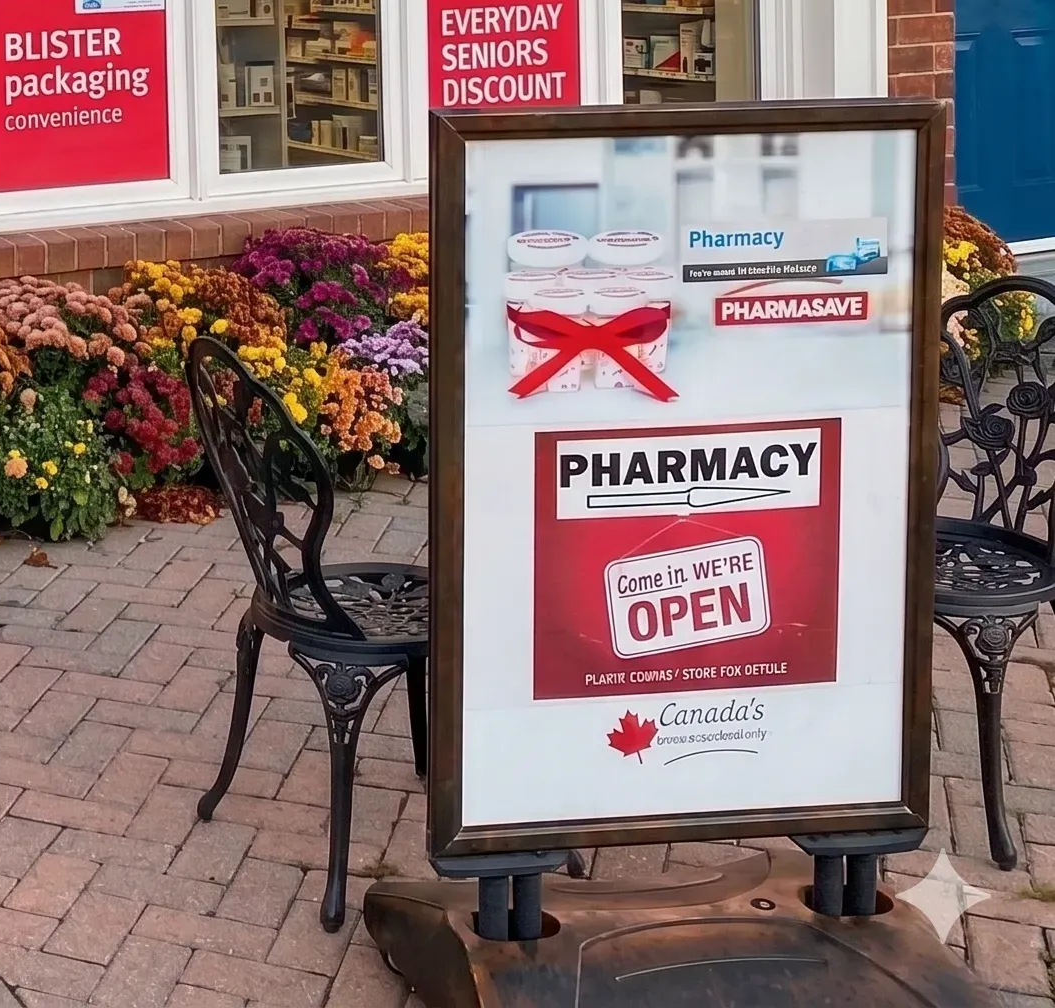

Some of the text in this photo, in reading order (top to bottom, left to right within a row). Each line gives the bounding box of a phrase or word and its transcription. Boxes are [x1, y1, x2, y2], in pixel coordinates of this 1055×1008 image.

[441, 3, 563, 37] EVERYDAY
[5, 27, 122, 62] BLISTER
[441, 38, 549, 71] SENIORS
[5, 62, 150, 106] packaging
[442, 72, 567, 106] DISCOUNT
[5, 106, 123, 131] convenience
[689, 230, 785, 249] Pharmacy
[721, 296, 863, 321] PHARMASAVE
[559, 442, 818, 488] PHARMACY
[617, 574, 664, 595] Come
[692, 552, 754, 580] WE'RE
[627, 582, 752, 643] OPEN
[682, 666, 718, 681] STORE
[720, 665, 742, 678] FOX
[659, 698, 765, 727] Canada's
